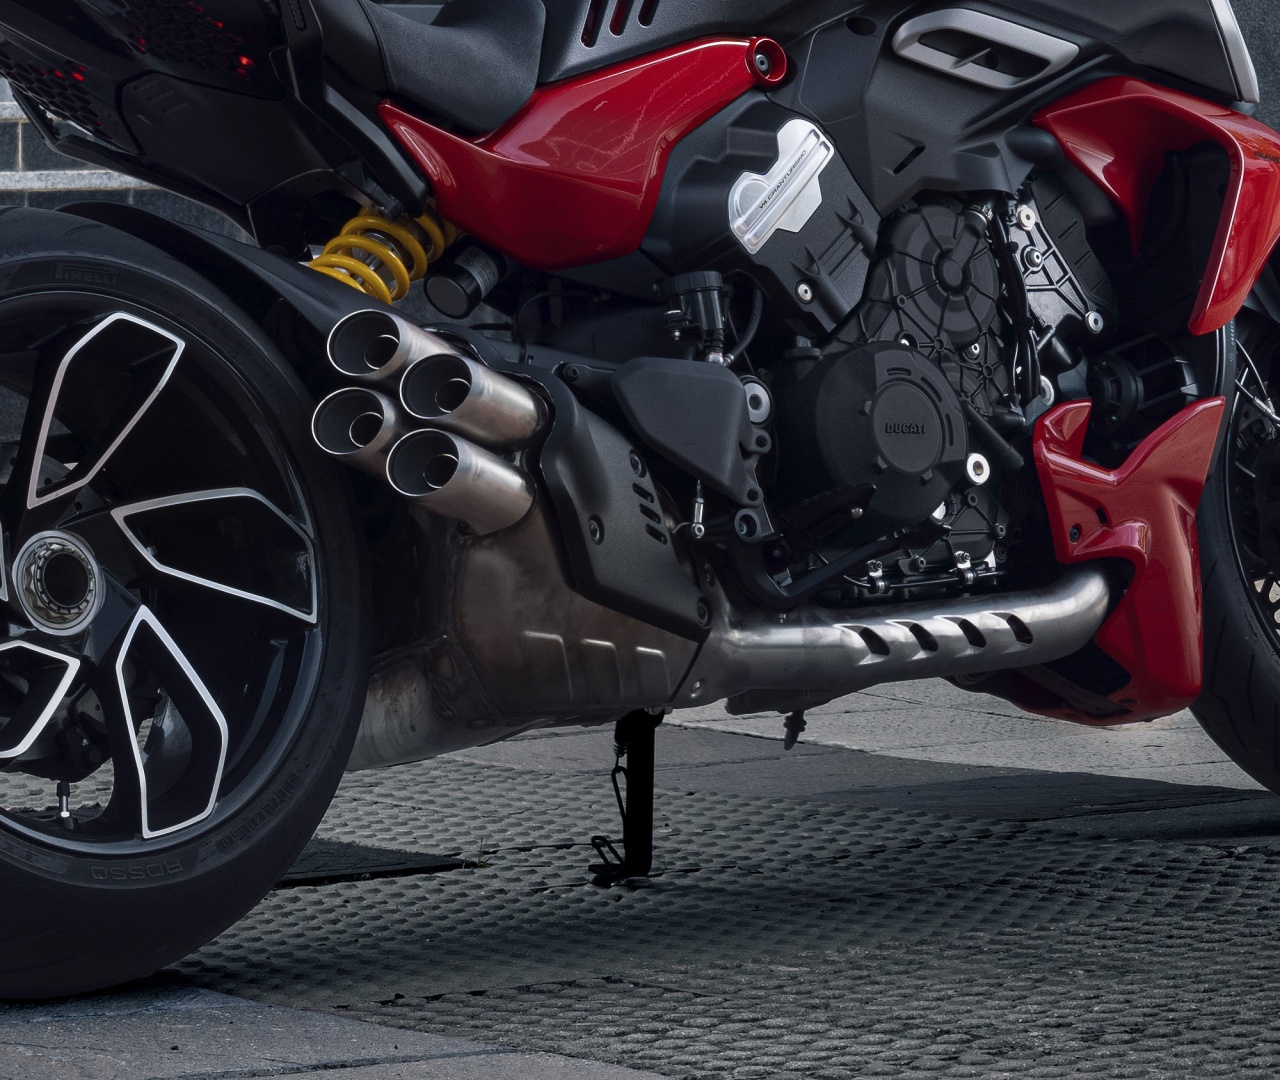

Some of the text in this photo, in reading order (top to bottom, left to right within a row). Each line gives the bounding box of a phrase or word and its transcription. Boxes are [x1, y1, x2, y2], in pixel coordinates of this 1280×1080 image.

[767, 149, 807, 200] GRANTURISMO
[55, 262, 120, 288] PIRELLI
[884, 422, 926, 435] DUCATI
[216, 772, 303, 853] DIABLO
[91, 858, 185, 881] ROSSO
